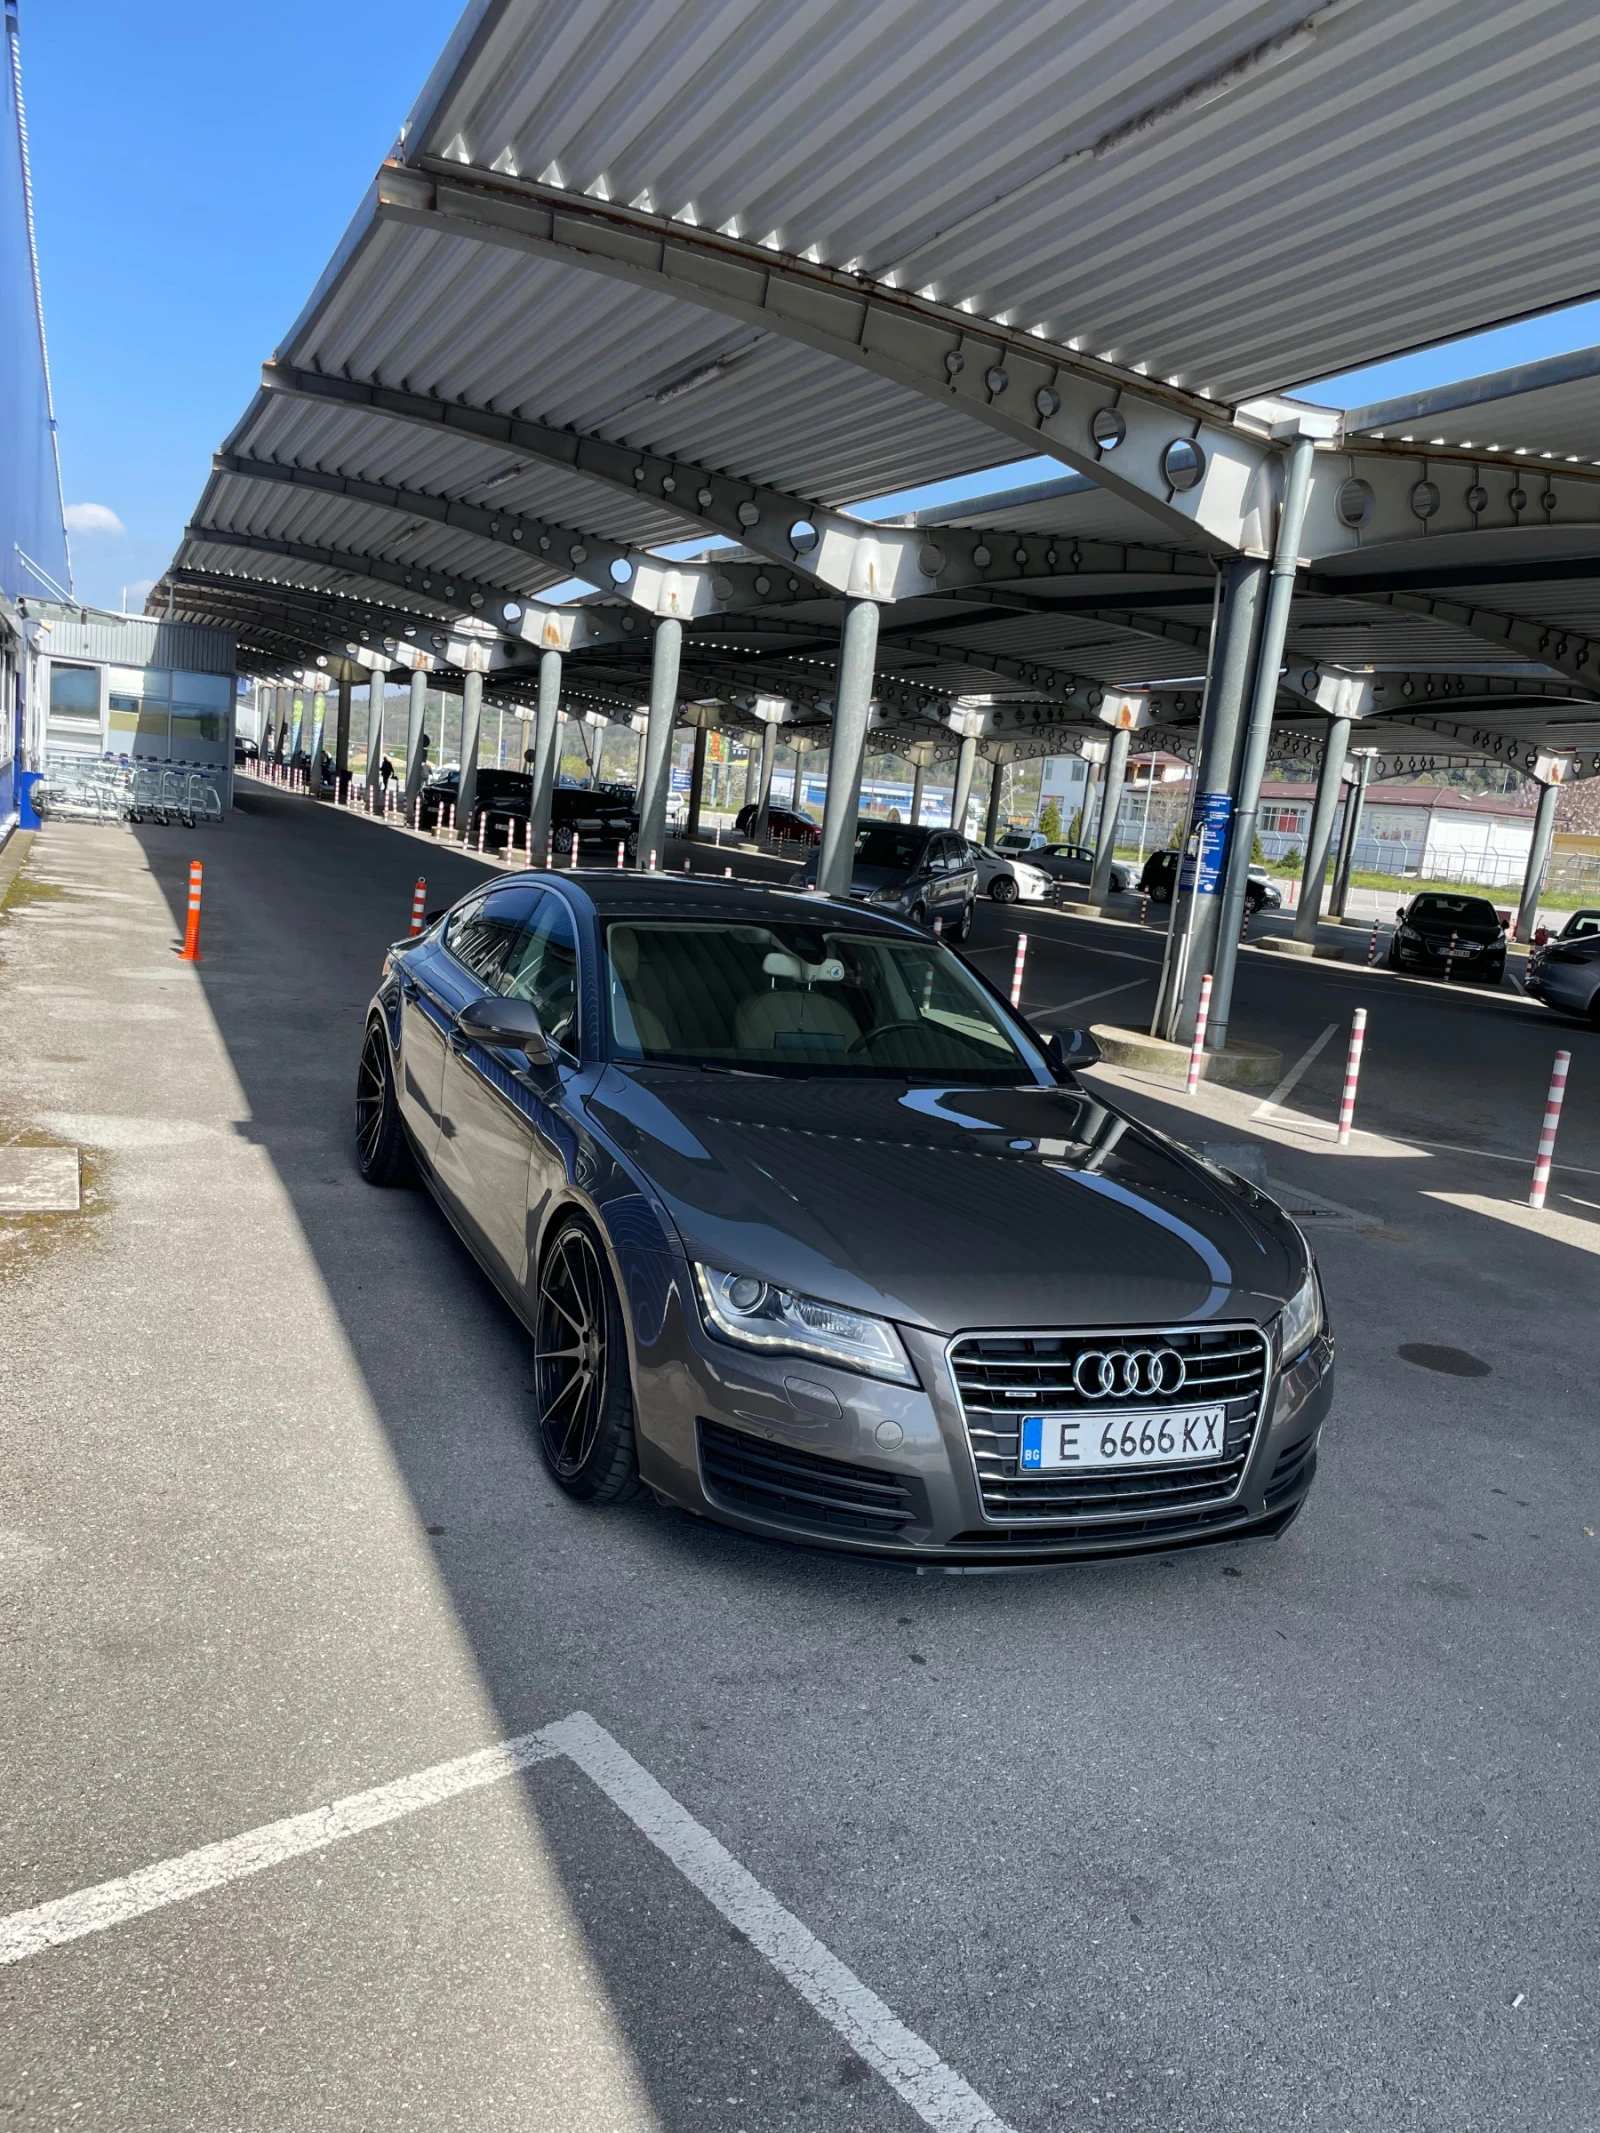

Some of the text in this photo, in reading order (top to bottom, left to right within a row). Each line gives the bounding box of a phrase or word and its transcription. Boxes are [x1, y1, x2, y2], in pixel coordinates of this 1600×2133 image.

[1059, 1414, 1219, 1460] E 6666 KX
[1024, 1449, 1040, 1461] BG
